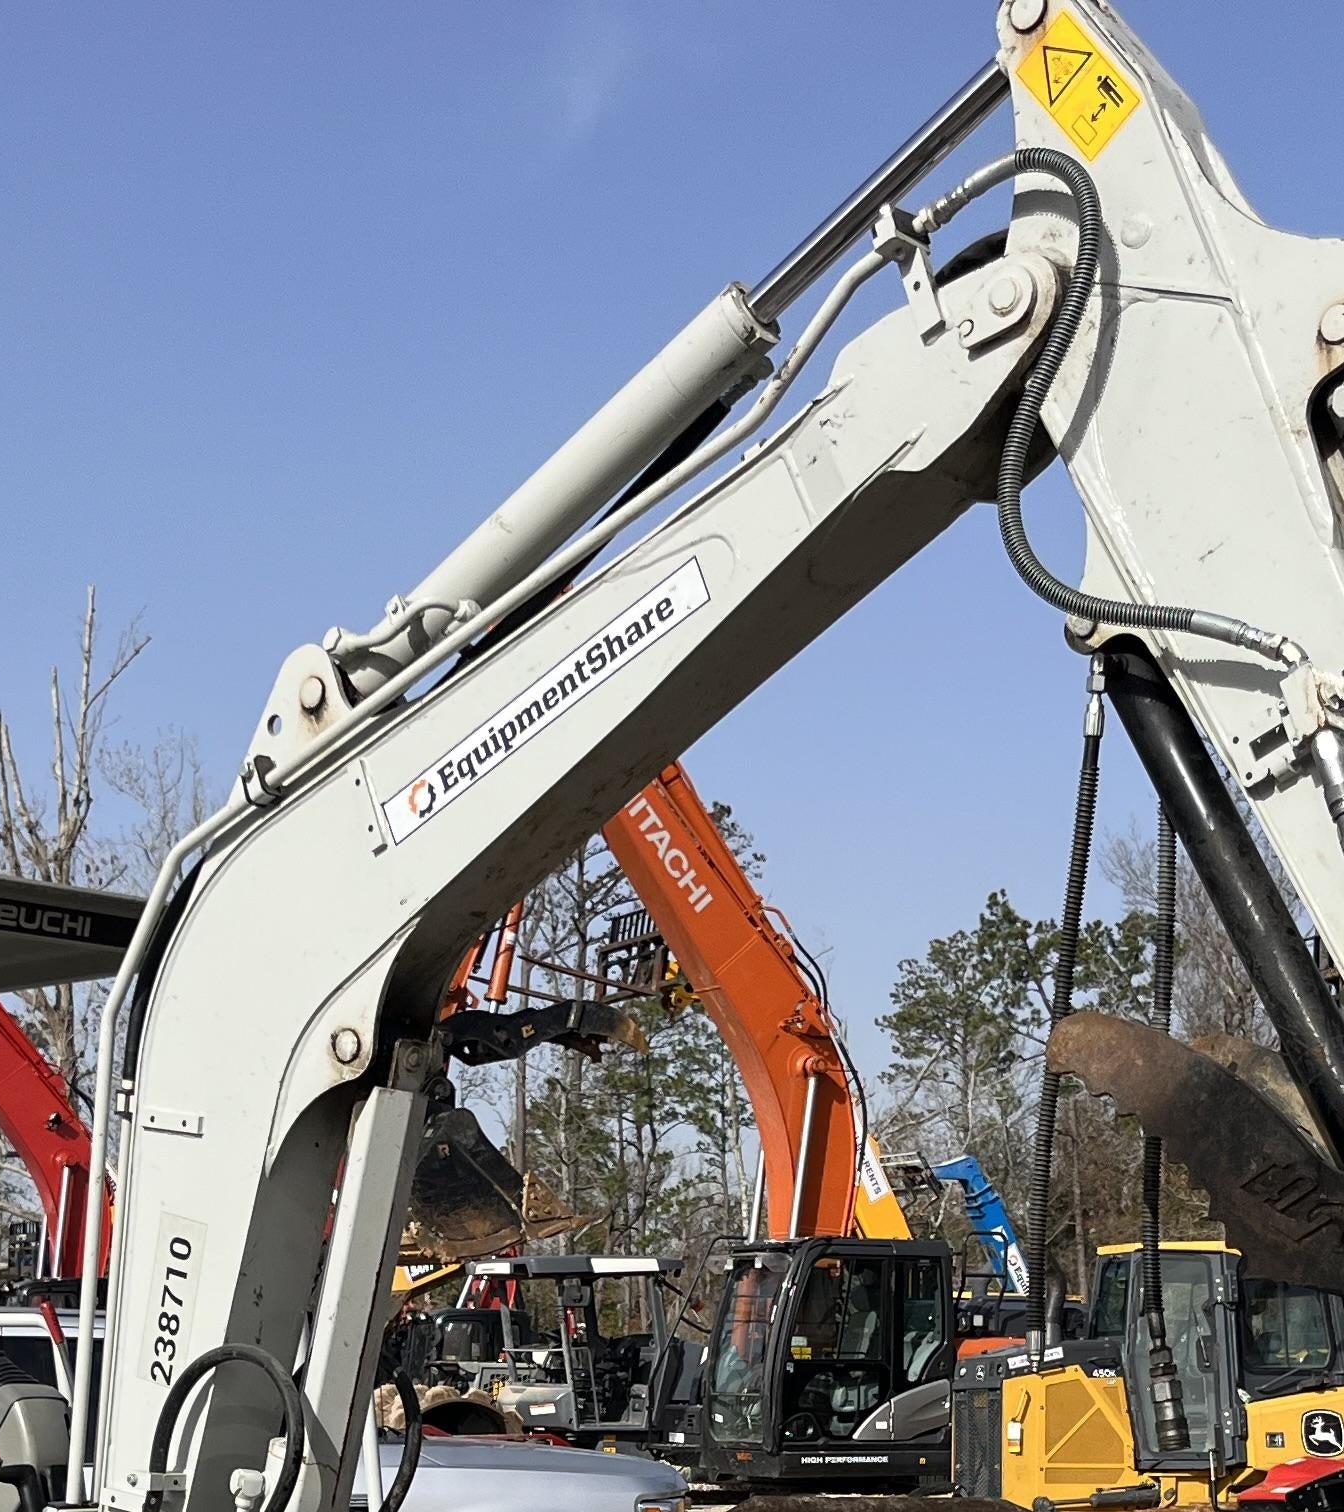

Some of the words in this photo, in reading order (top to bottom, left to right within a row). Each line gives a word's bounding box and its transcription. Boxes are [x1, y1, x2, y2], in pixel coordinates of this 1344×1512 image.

[437, 597, 674, 795] EquipmentShare
[629, 798, 713, 913] ITACHI
[150, 1236, 192, 1386] 238710
[801, 1456, 823, 1464] HIGH
[825, 1456, 888, 1464] PERFORMANCE
